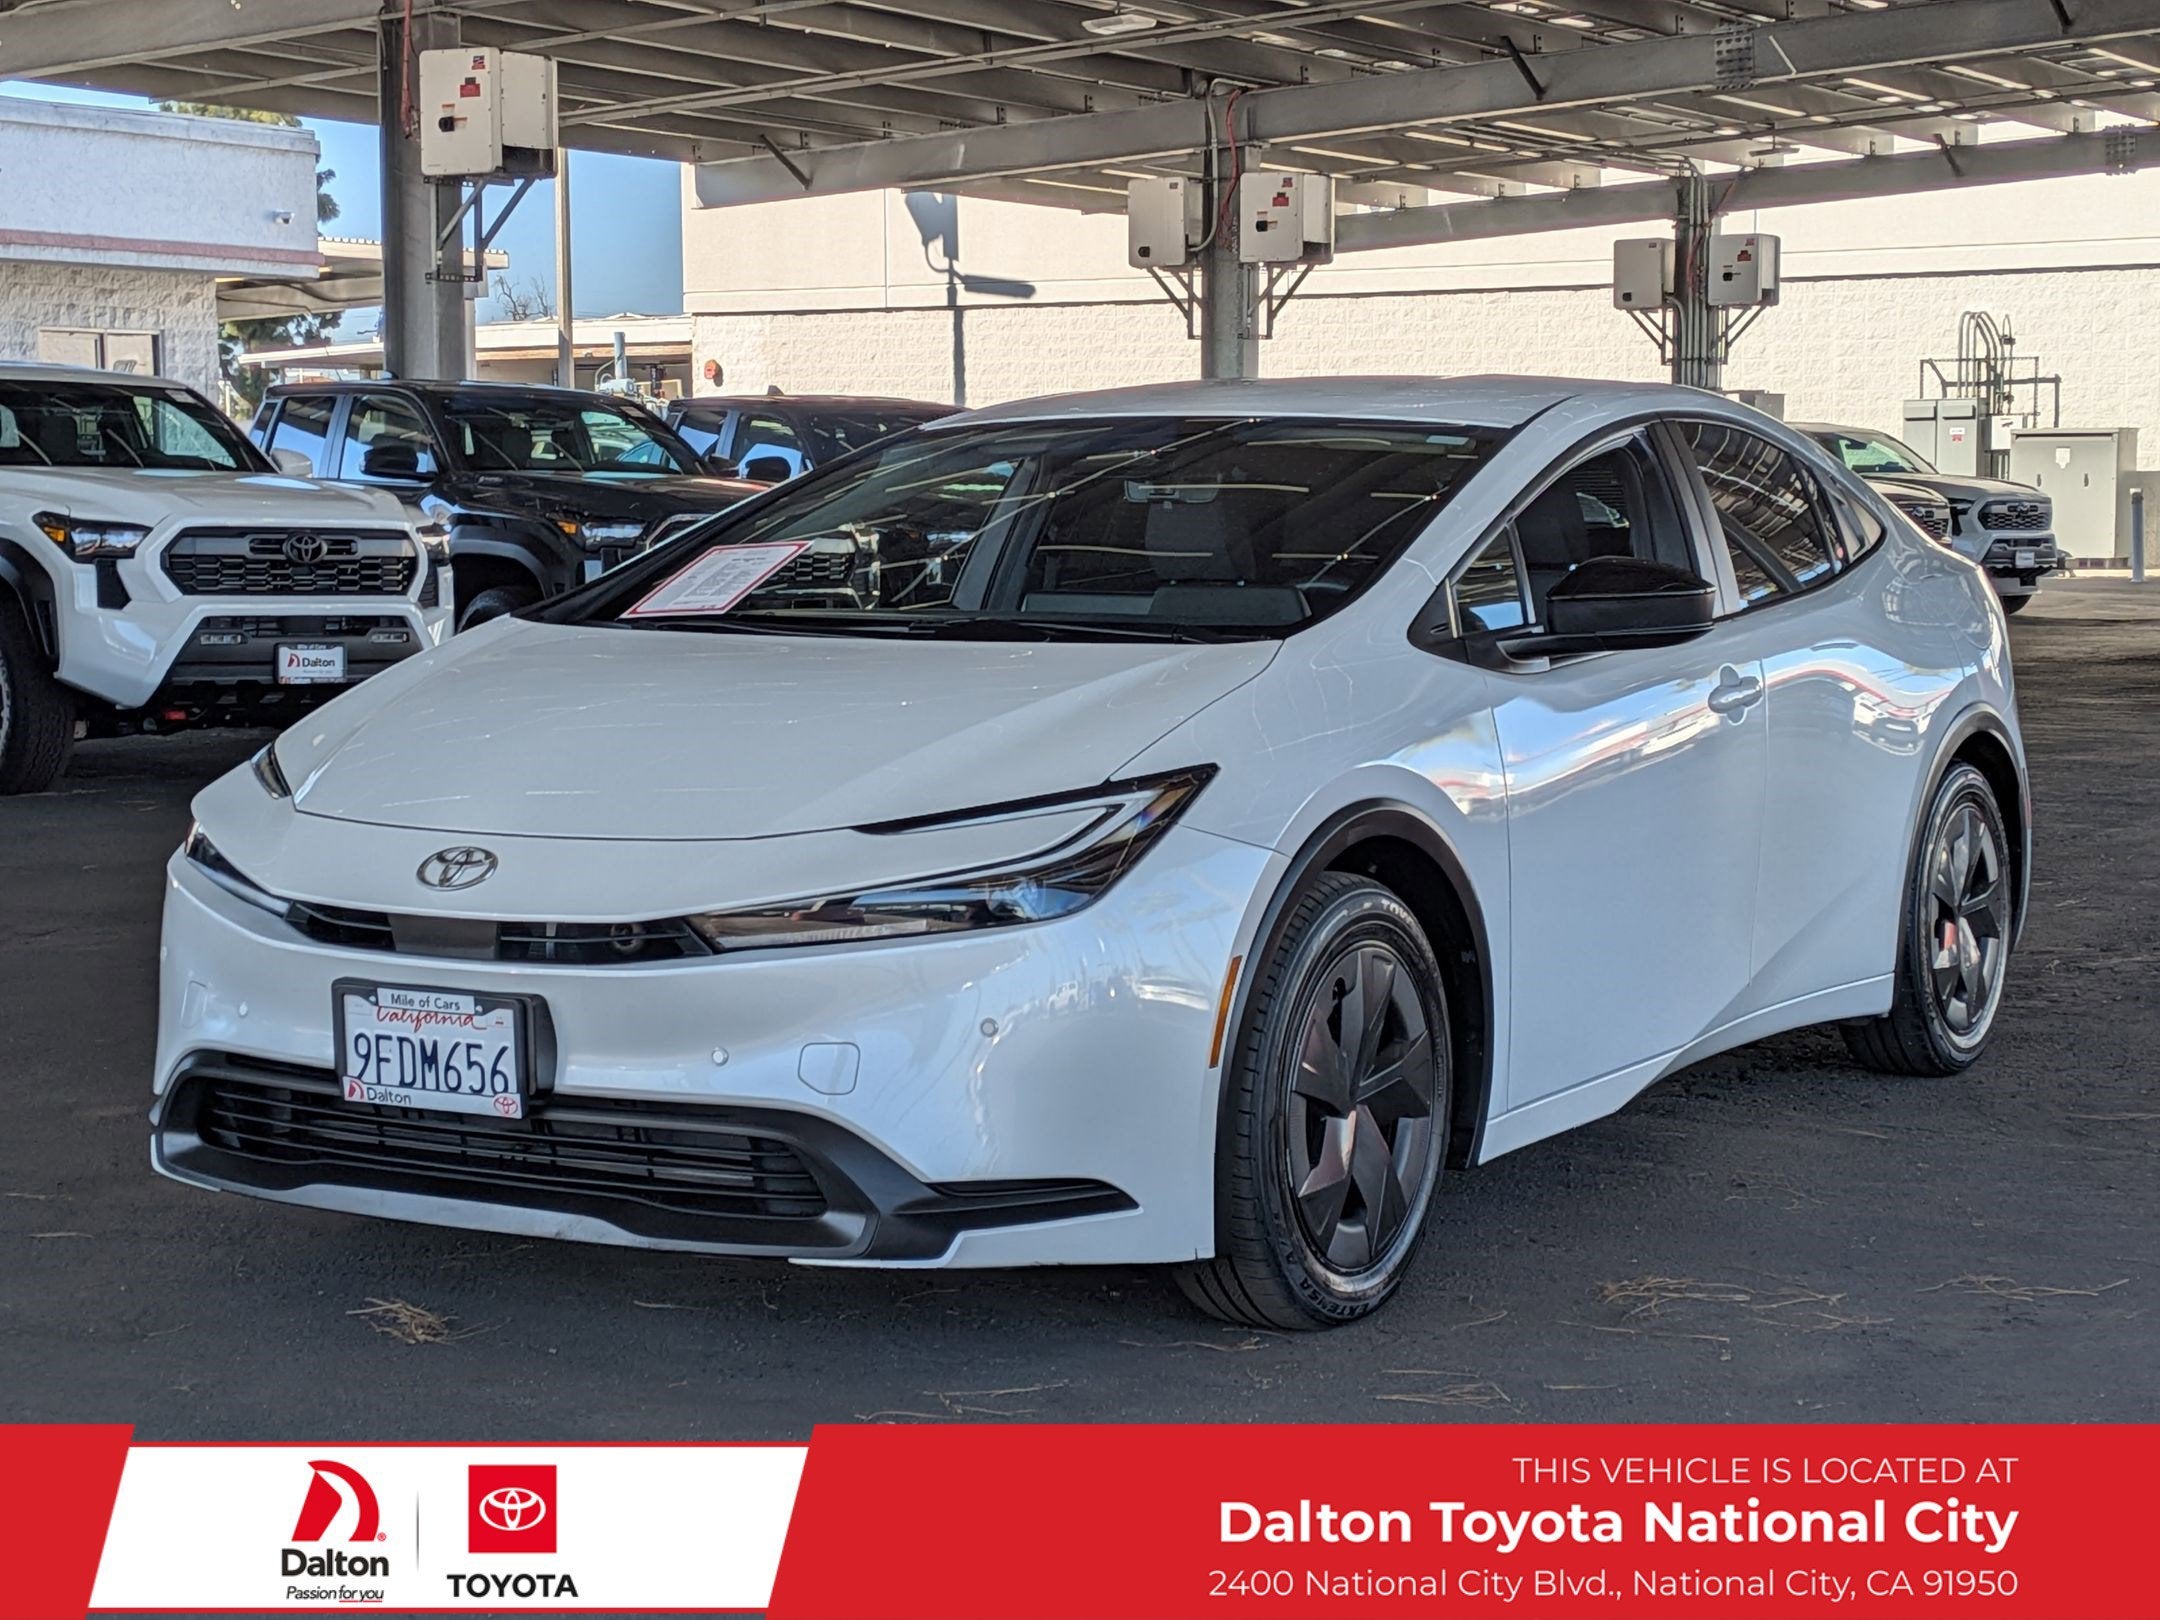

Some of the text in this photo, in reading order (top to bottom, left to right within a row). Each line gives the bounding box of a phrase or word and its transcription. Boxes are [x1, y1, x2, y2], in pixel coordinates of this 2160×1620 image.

[302, 657, 335, 667] Dalton
[391, 993, 460, 1011] Mile of Cars
[354, 1032, 510, 1095] 9FDM656
[367, 1087, 412, 1105] Dalton
